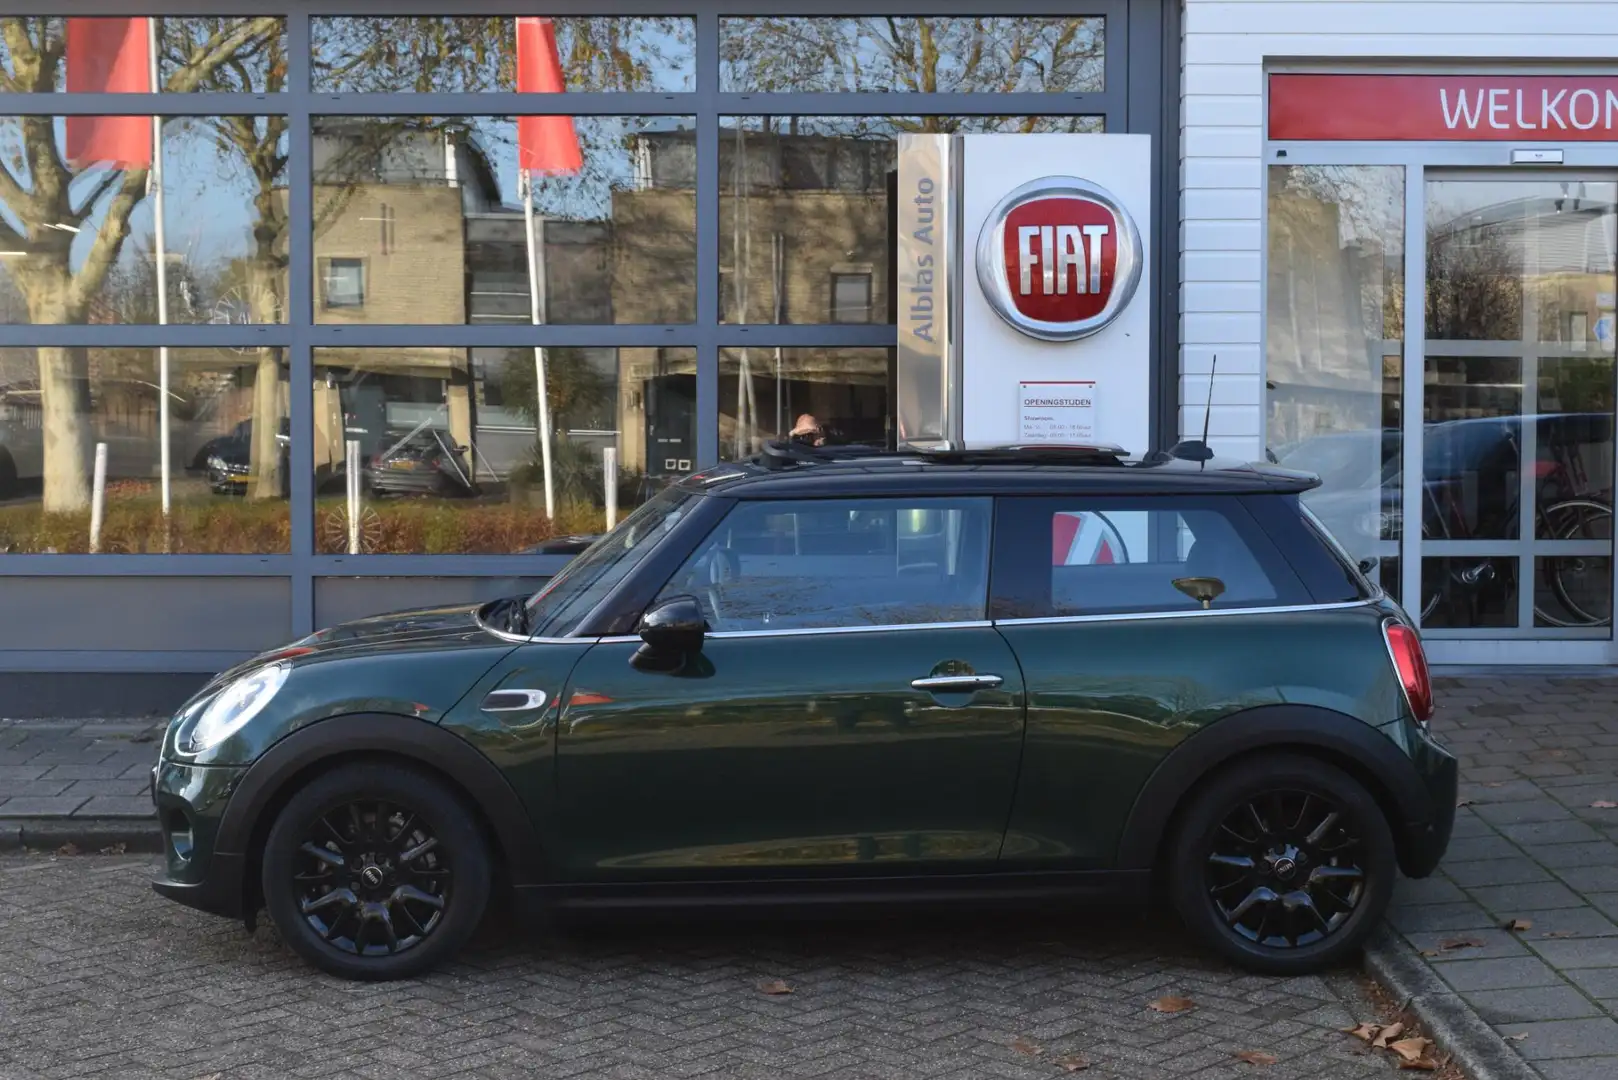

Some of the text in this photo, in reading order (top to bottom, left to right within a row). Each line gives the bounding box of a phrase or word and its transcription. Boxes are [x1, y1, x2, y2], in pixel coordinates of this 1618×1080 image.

[910, 177, 935, 344] Alblas Auto
[1017, 224, 1109, 296] FIAT
